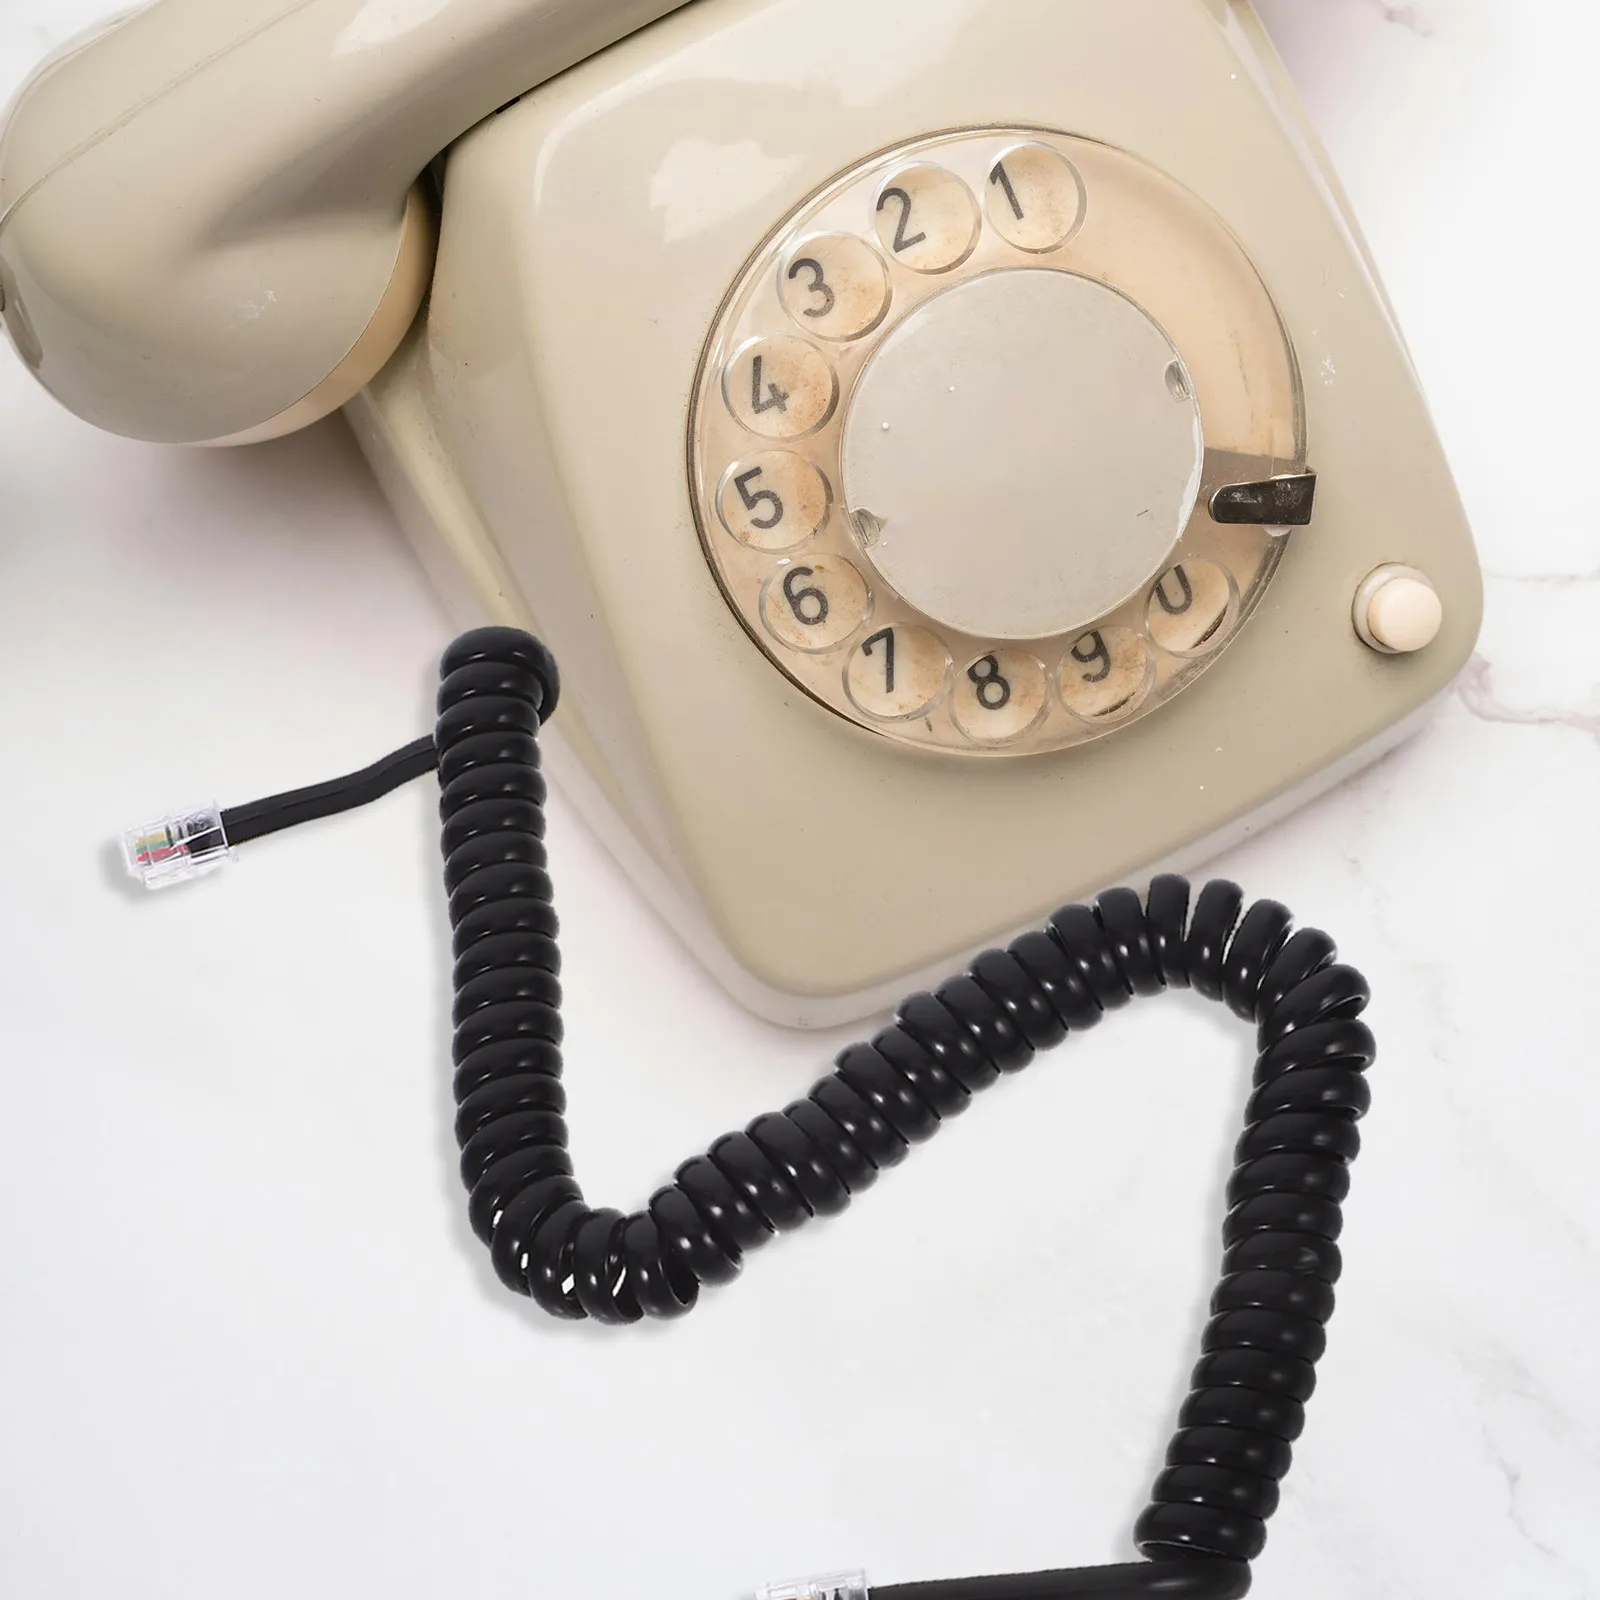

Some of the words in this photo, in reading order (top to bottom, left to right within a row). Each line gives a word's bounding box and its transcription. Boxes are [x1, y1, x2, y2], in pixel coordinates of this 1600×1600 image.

[876, 187, 926, 253] 2
[990, 161, 1025, 220] 1
[788, 258, 835, 318] 3
[750, 355, 789, 415] 4
[734, 466, 783, 529] 5
[783, 566, 829, 626] 6
[862, 628, 895, 694] 7
[967, 653, 1011, 710] 8
[1070, 631, 1112, 683] 9
